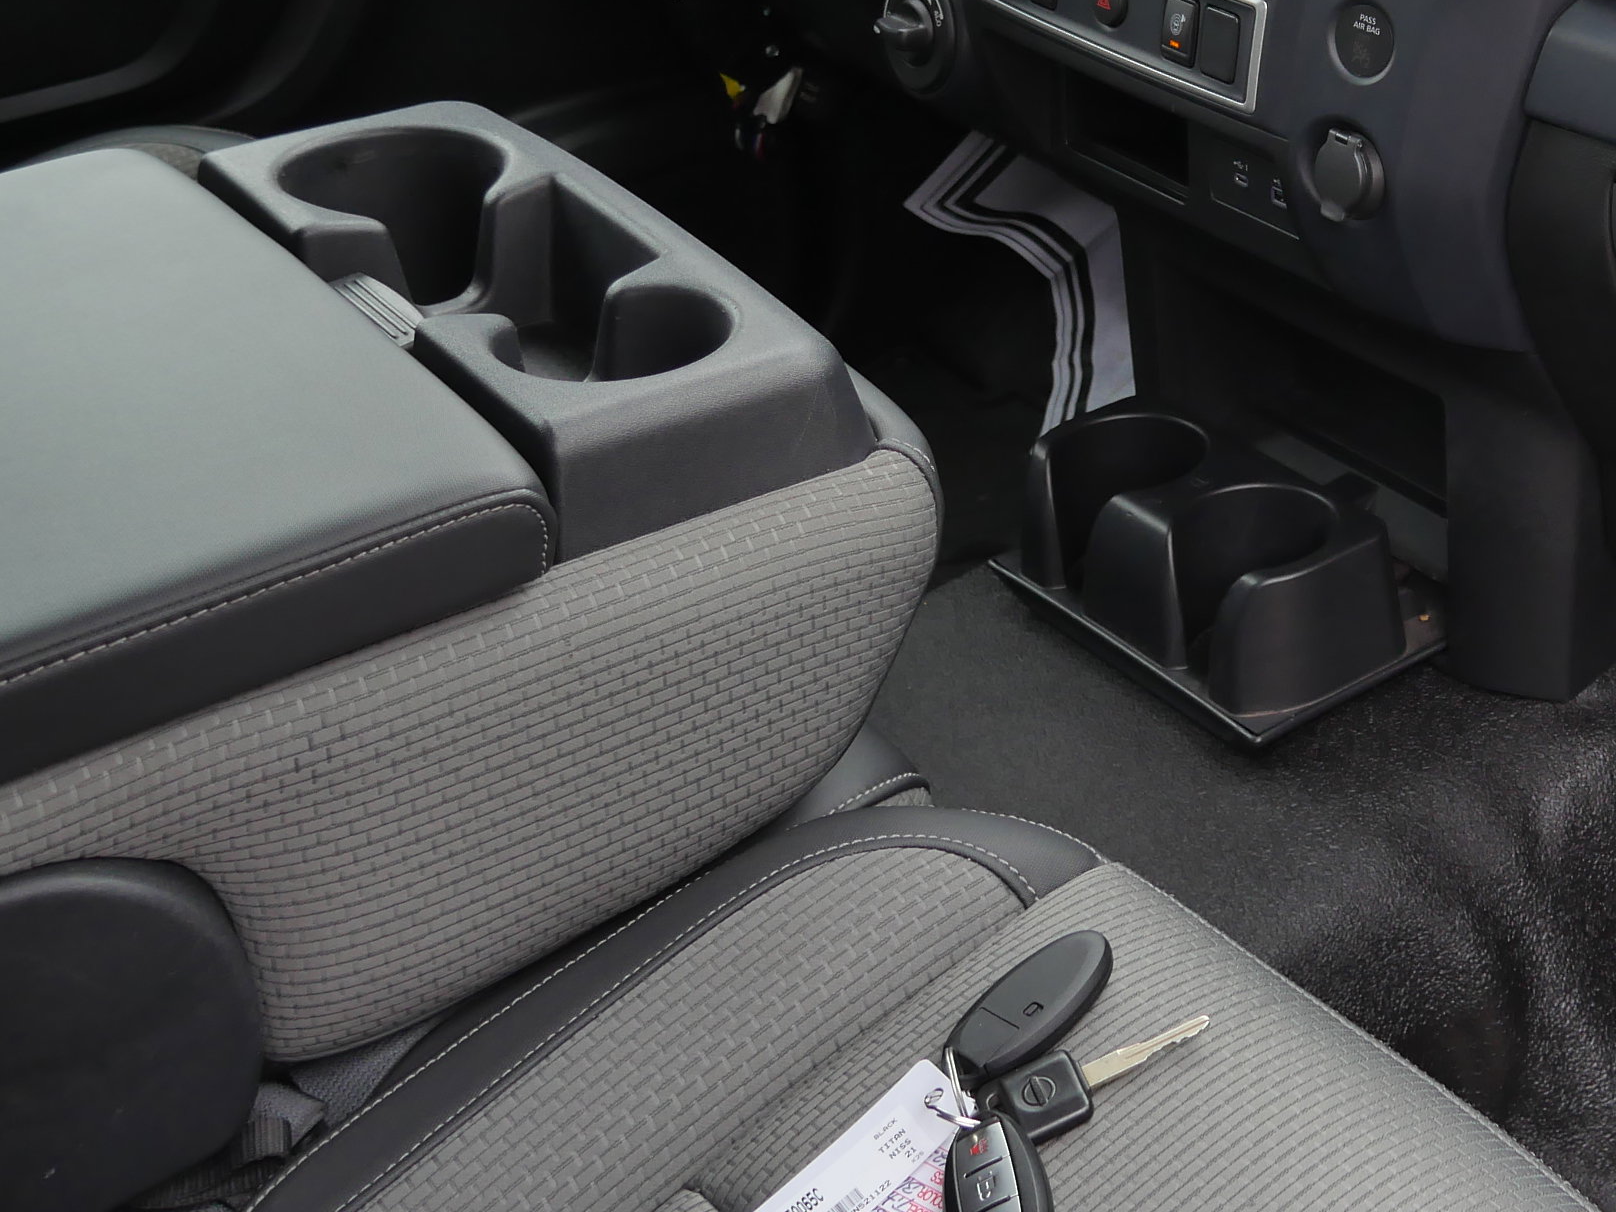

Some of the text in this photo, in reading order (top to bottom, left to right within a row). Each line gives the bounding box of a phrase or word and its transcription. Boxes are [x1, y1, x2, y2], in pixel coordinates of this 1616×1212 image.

[1352, 21, 1381, 36] AIR BAG
[1360, 13, 1376, 26] PASS
[877, 1128, 907, 1154] TITAN
[888, 1138, 912, 1160] NISS
[904, 1146, 917, 1159] 21
[849, 1179, 892, 1212] N521122
